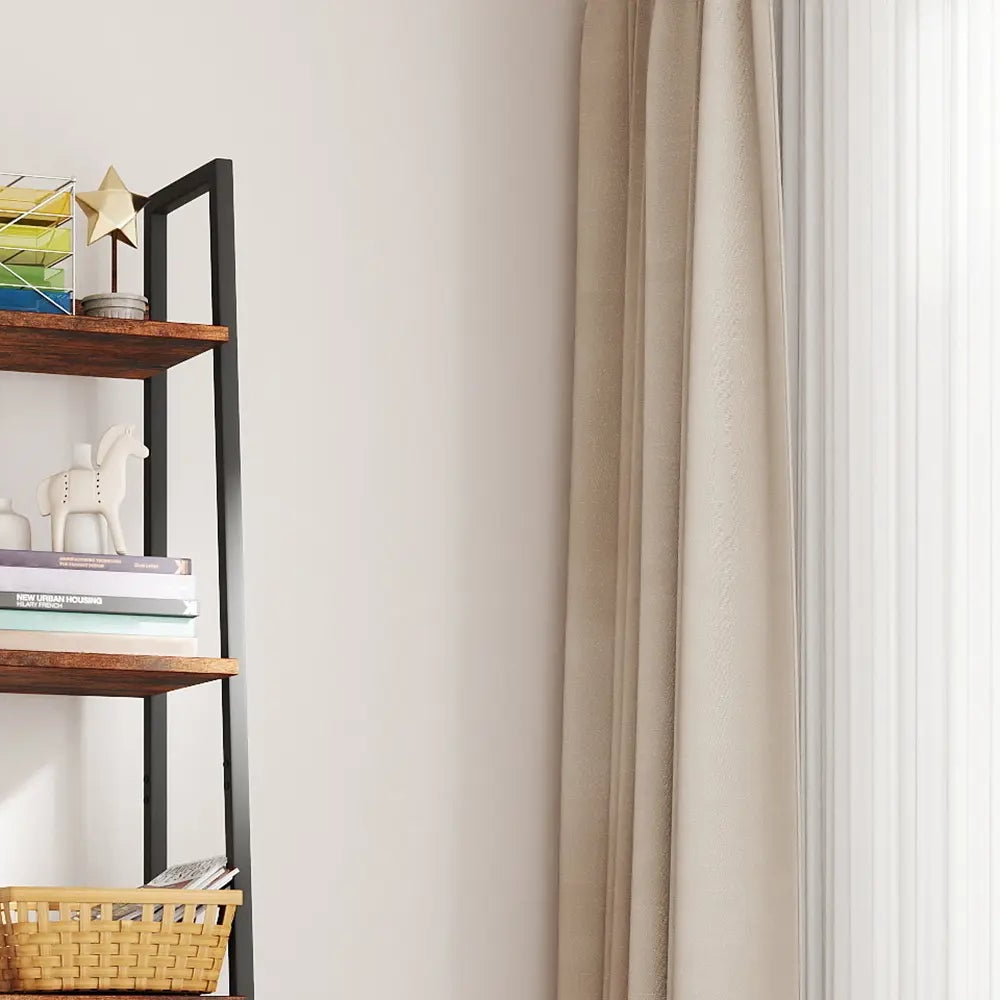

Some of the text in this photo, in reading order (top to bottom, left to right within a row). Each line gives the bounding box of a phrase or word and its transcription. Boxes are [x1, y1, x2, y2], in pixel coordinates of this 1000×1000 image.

[16, 593, 103, 605] NEW URBAN HOUSING
